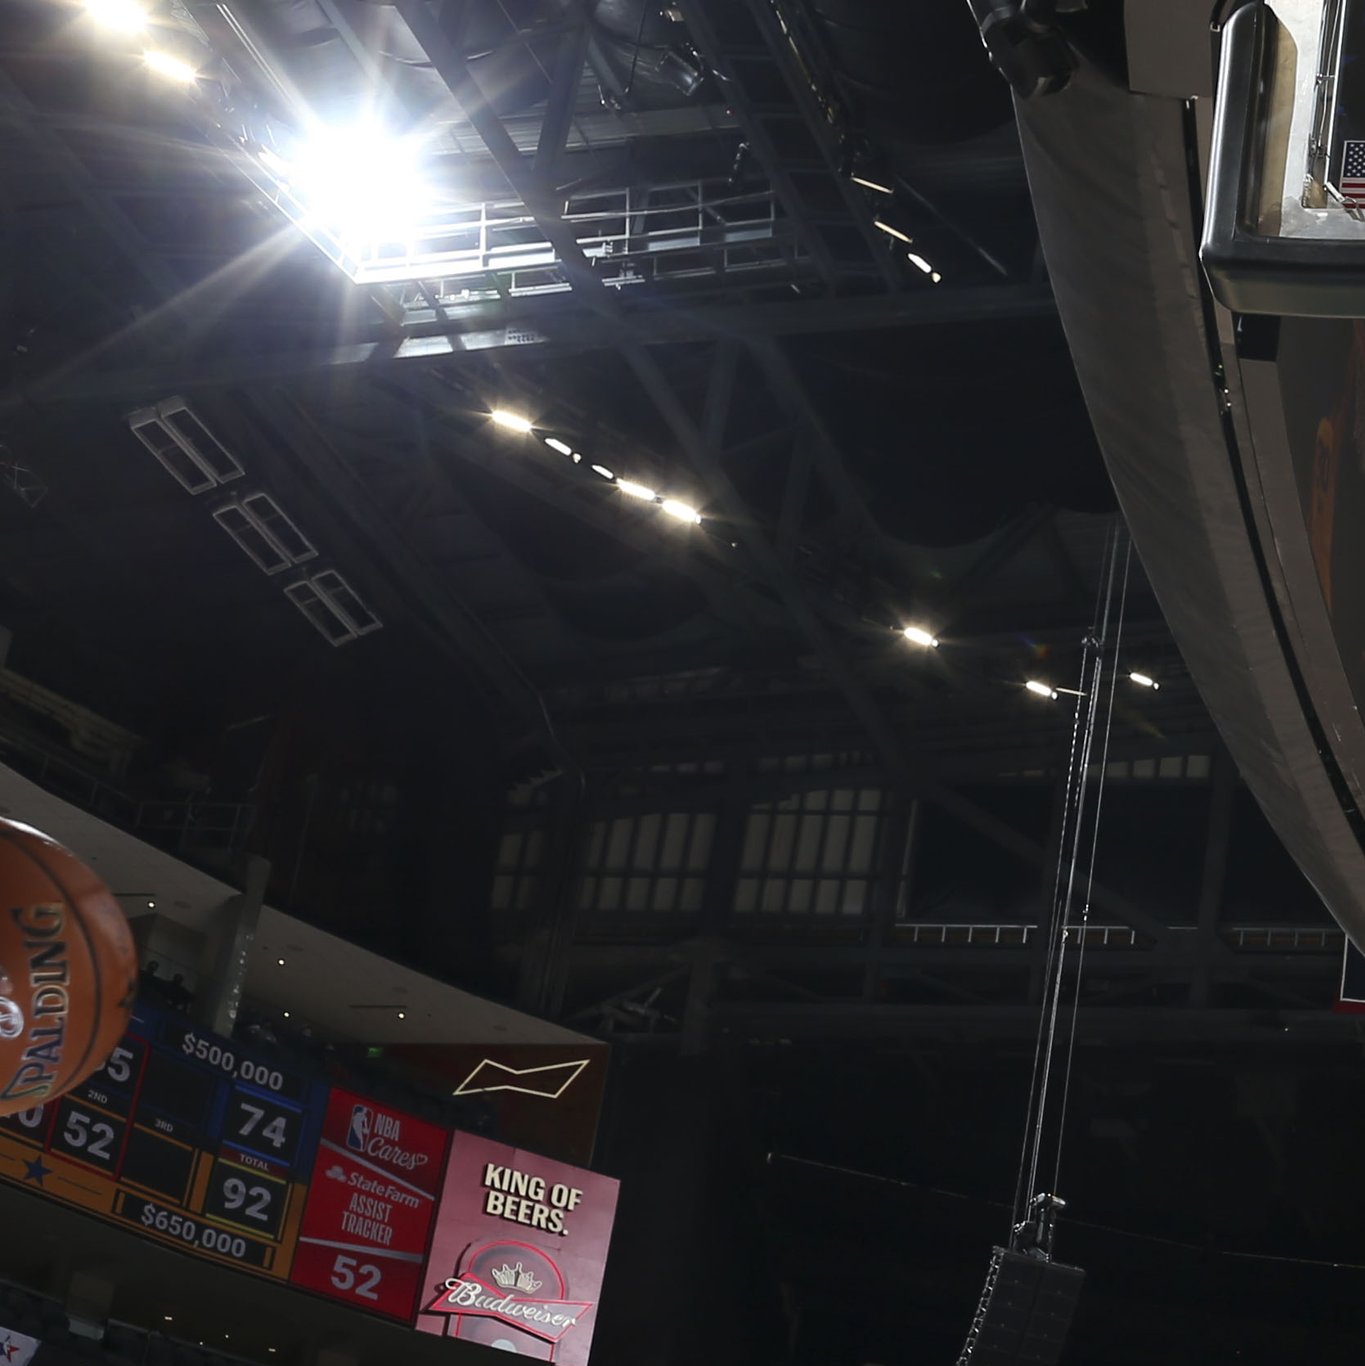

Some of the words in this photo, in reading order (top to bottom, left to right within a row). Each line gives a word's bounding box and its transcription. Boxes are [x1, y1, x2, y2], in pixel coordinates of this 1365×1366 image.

[181, 1031, 284, 1091] $500,000
[88, 1088, 108, 1105] 2ND
[63, 1110, 115, 1160] 52
[155, 1119, 174, 1133] 3RD
[239, 1102, 287, 1149] 74
[373, 1113, 401, 1141] NBA
[240, 1153, 270, 1171] TOTAL
[367, 1136, 418, 1171] Cares
[223, 1177, 272, 1221] 92
[350, 1191, 393, 1224] ASSIST
[484, 1162, 545, 1201] KING
[550, 1183, 583, 1212] OF
[141, 1203, 246, 1259] $650,000
[341, 1211, 393, 1246] TRACKER
[486, 1189, 569, 1236] BEERS.
[330, 1254, 383, 1300] 52
[445, 1278, 577, 1329] Budweiser
